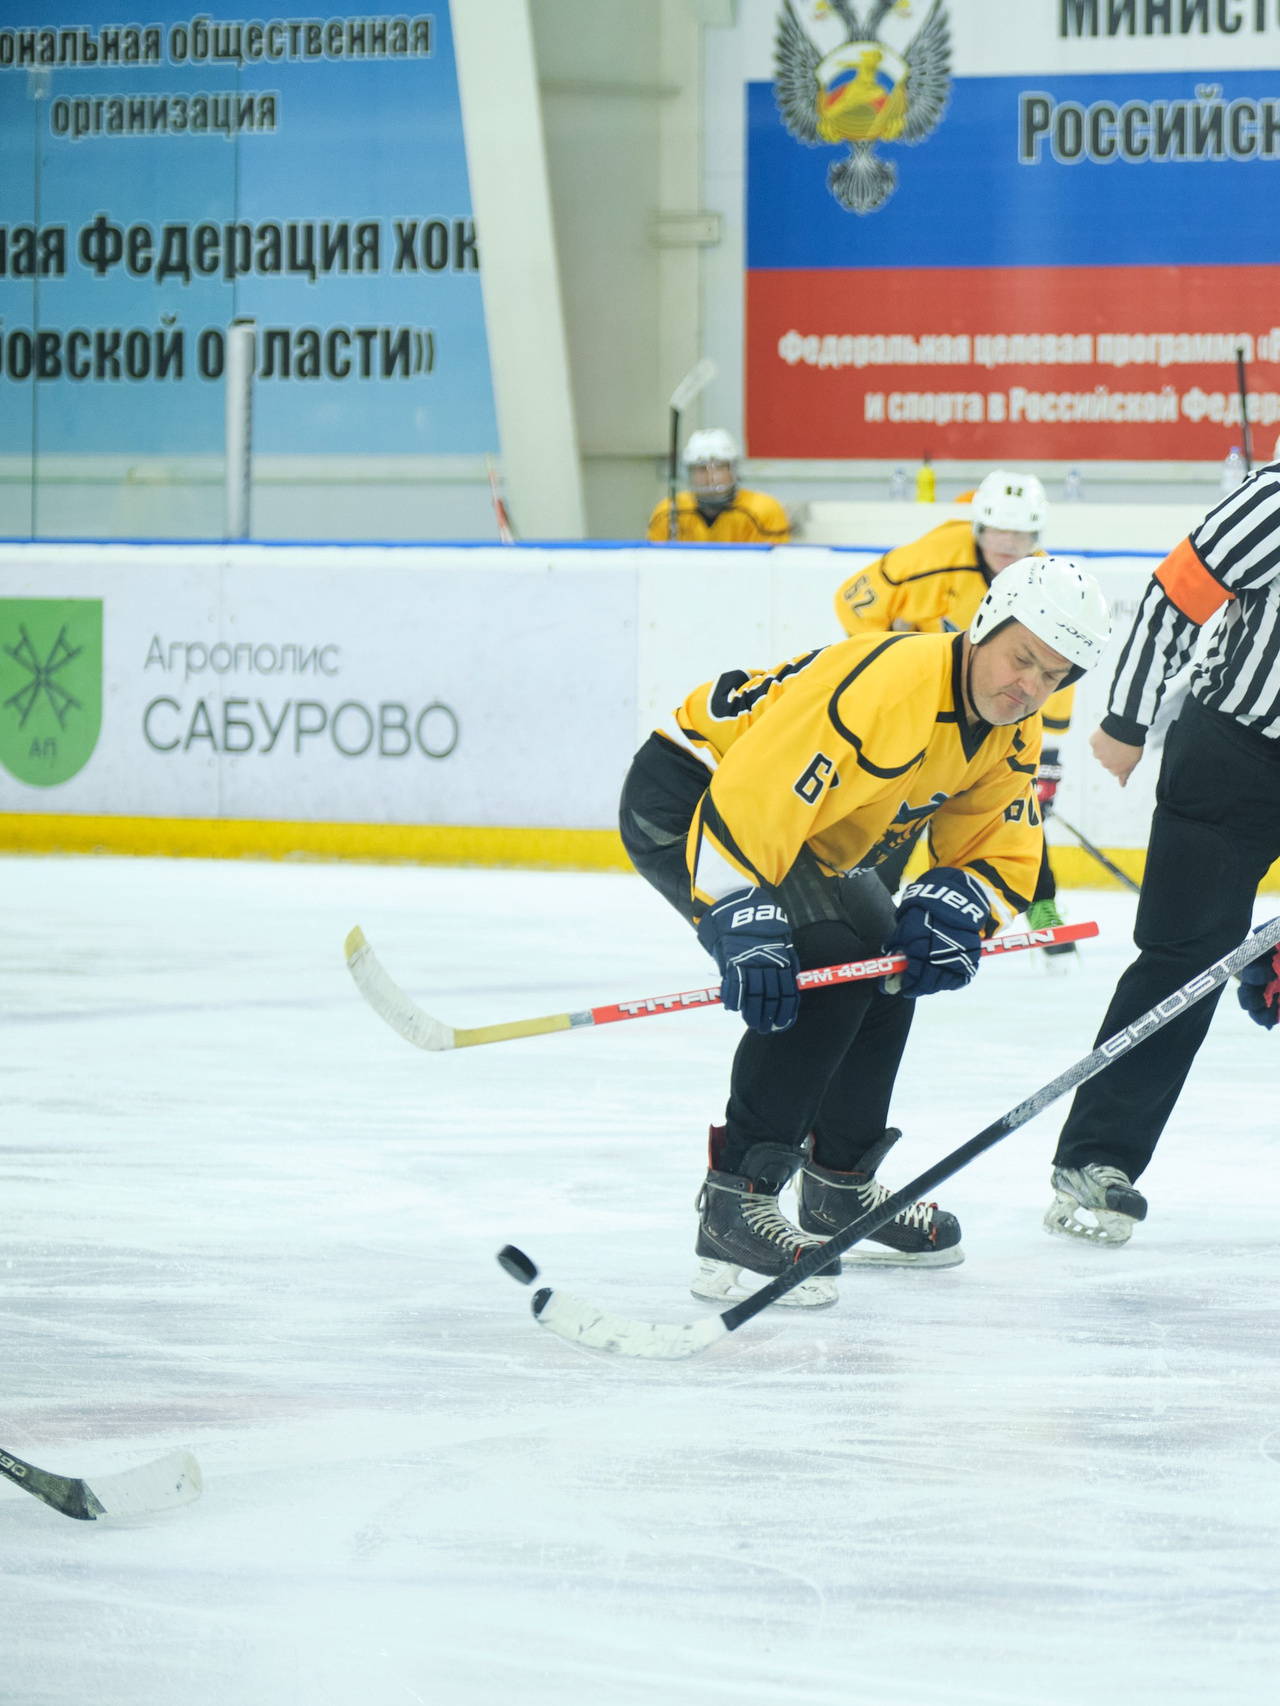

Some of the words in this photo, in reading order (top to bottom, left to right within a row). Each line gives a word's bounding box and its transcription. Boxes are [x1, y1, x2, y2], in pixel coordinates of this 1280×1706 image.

[170, 17, 431, 65] общественная
[51, 94, 278, 139] организация
[0, 226, 66, 276] ая
[80, 214, 380, 284] Федерация
[0, 316, 184, 379] овской
[201, 320, 435, 379] оласти»
[778, 329, 971, 370] Федеральная
[973, 333, 1094, 369] целевая
[864, 391, 886, 423] и
[887, 391, 985, 426] спорта
[986, 391, 1008, 423] в
[1009, 384, 1179, 424] Российской
[143, 634, 342, 681] Агрополис
[142, 694, 460, 759] САБУРОВО
[798, 969, 834, 986] PM
[837, 959, 894, 979] 4020
[1100, 948, 1238, 1059] GHOST
